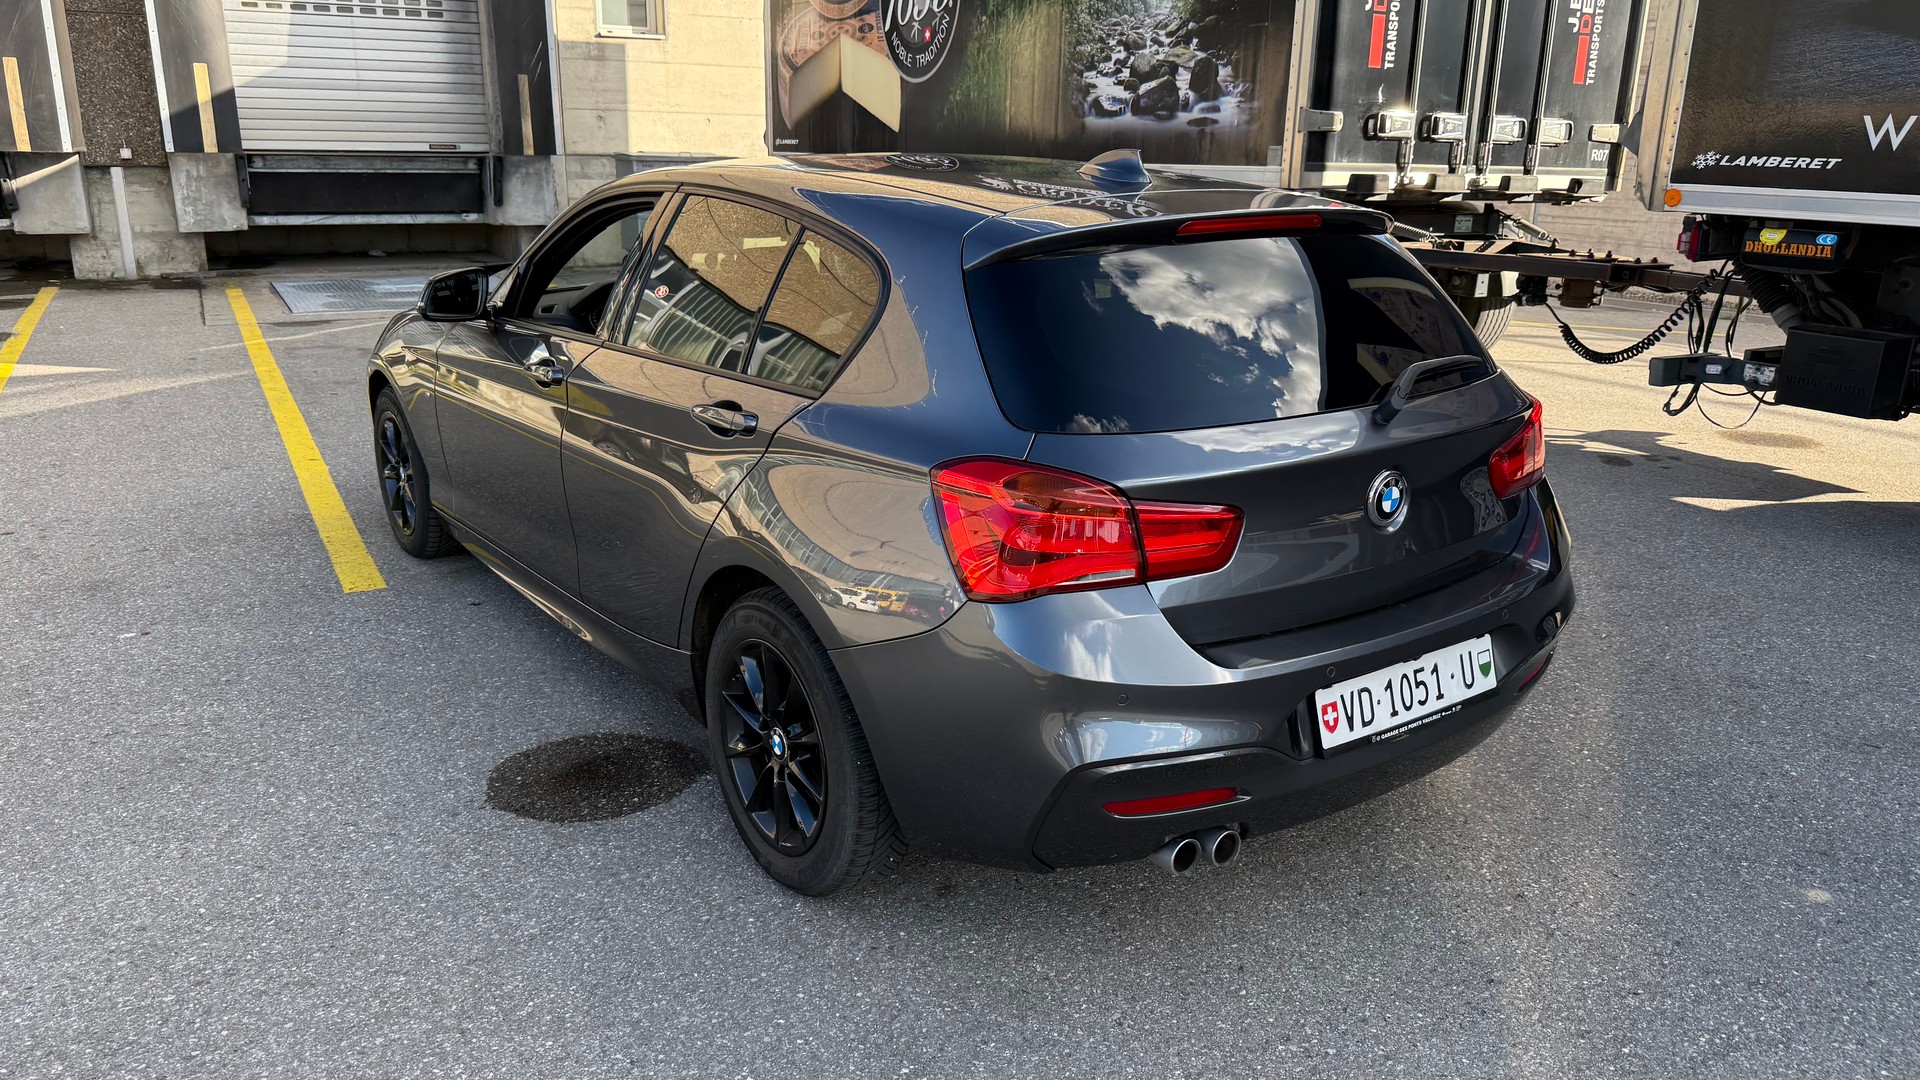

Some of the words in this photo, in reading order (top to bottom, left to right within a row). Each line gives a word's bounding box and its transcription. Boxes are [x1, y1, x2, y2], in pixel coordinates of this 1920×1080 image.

[891, 32, 913, 68] NOBLE
[916, 13, 950, 68] TRADITION
[1586, 0, 1606, 85] TRANSPORTS
[1590, 149, 1609, 161] R07
[1719, 154, 1843, 170] LAMBERET
[1745, 240, 1832, 258] DHOLLANDIA
[1381, 729, 1399, 739] GARAGE
[1400, 725, 1408, 733] DES
